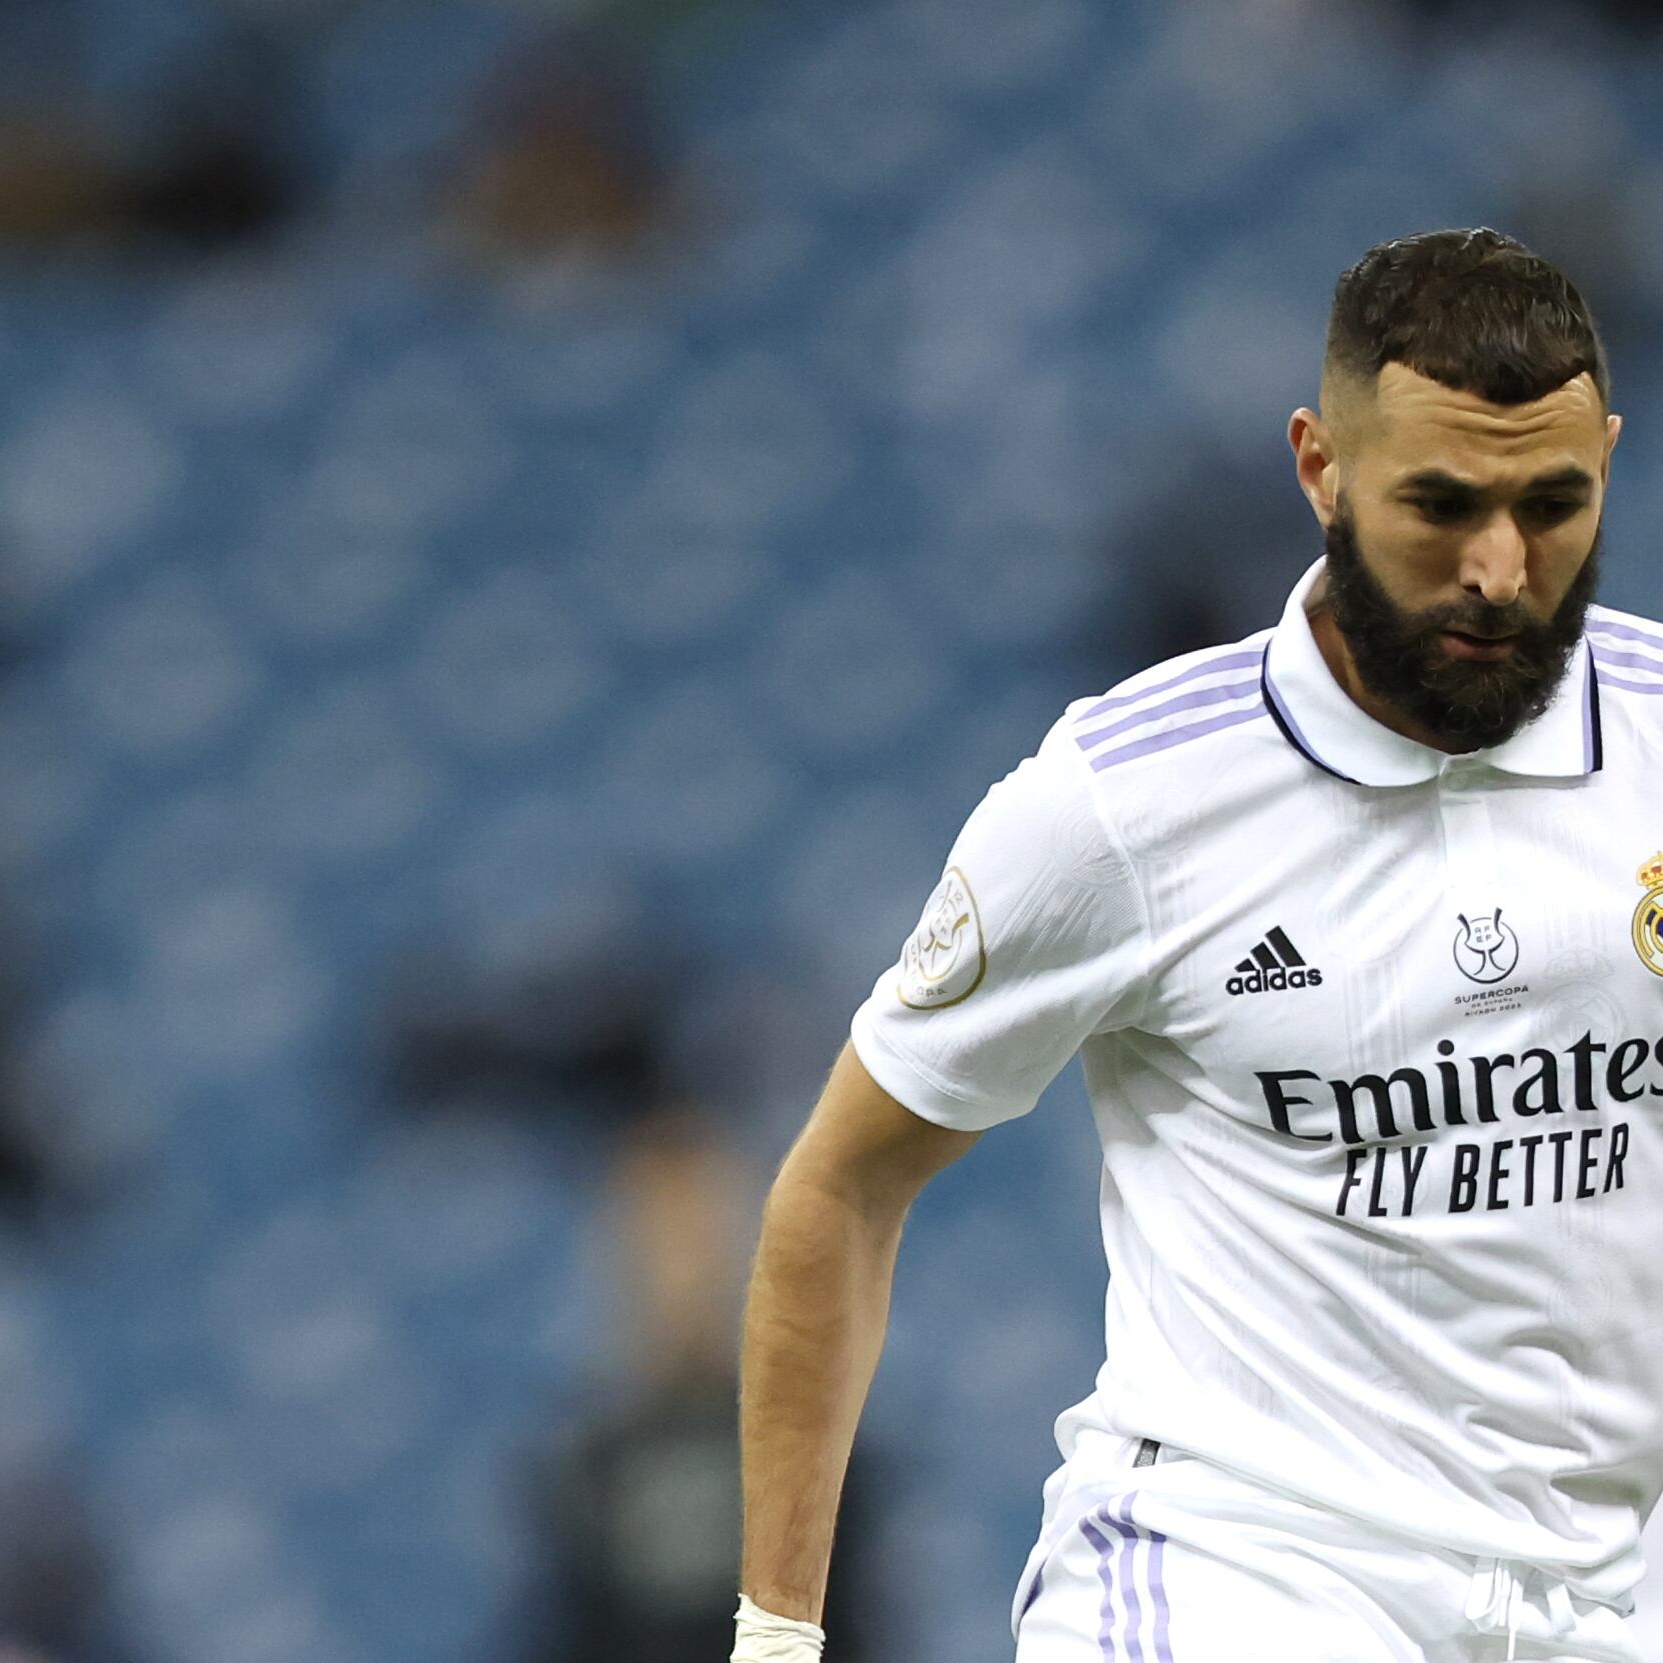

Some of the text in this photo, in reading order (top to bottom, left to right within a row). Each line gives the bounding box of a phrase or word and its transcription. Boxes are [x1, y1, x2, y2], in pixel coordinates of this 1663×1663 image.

[1225, 966, 1324, 996] adidas
[1454, 984, 1529, 1005] SUPERCOPA
[1335, 1122, 1629, 1217] FLY BETTER
